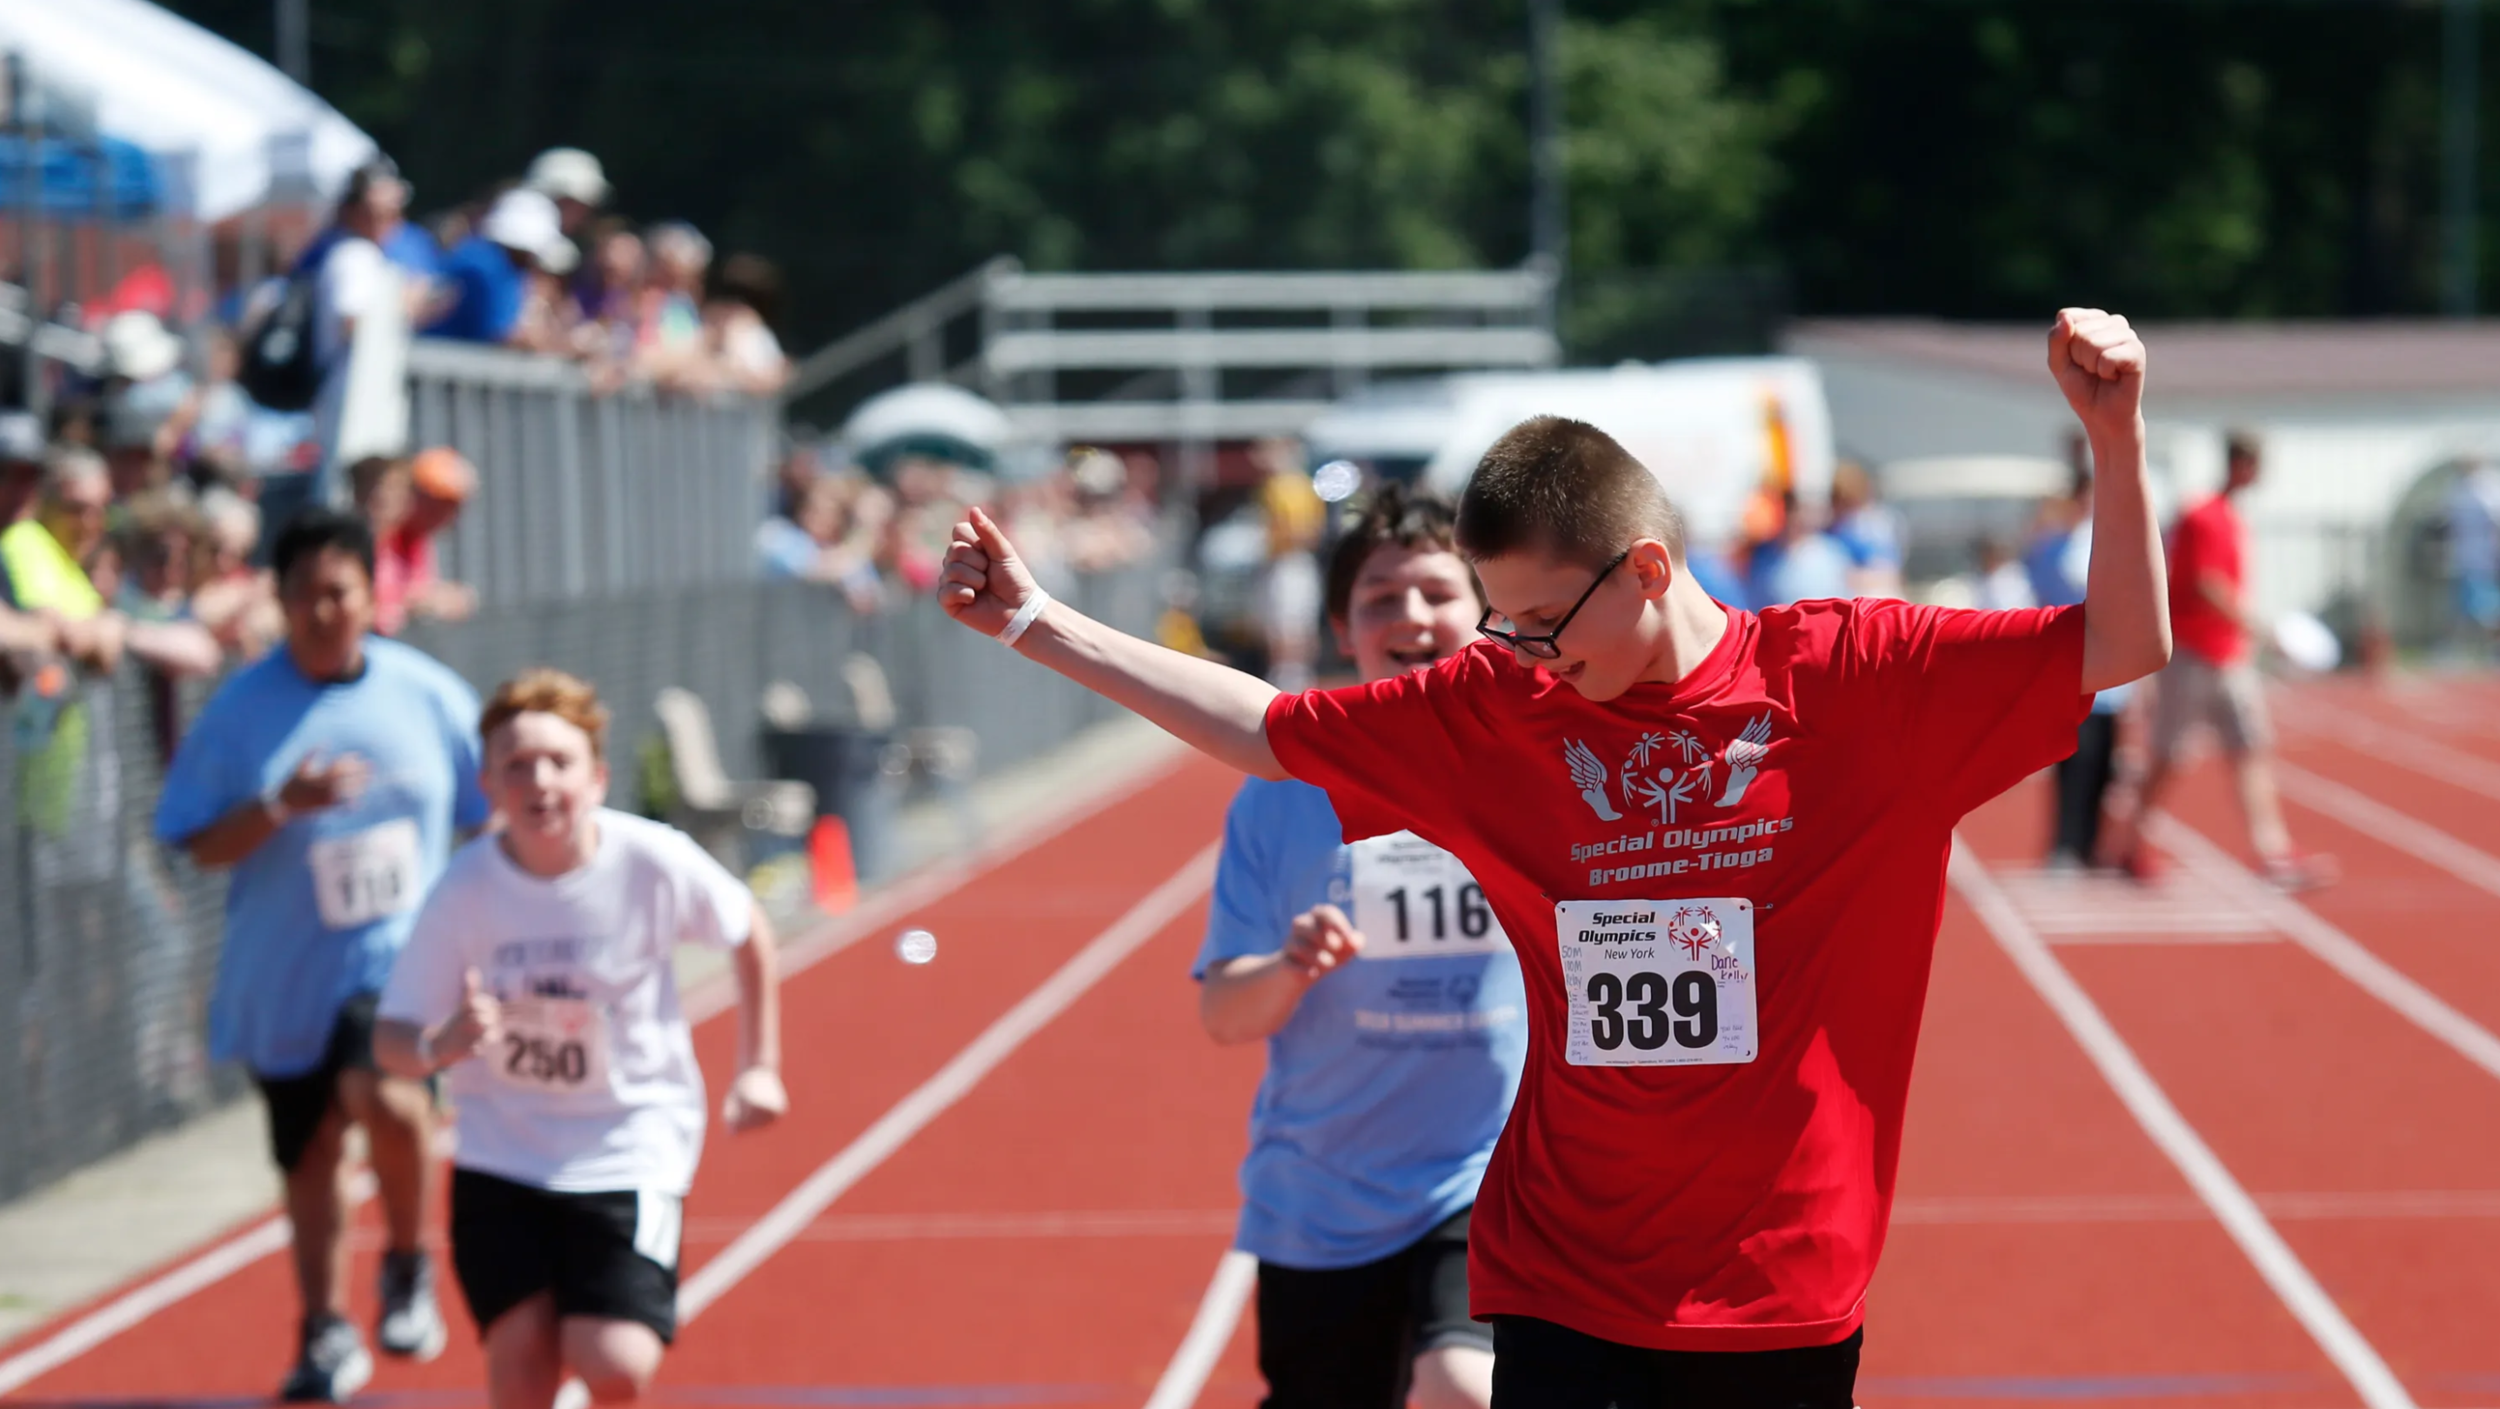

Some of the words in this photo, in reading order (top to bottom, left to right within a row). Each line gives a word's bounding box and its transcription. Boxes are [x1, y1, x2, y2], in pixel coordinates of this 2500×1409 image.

[1571, 832, 1654, 863] Special
[1663, 817, 1794, 849] Olympics
[1589, 847, 1773, 887] Broome-Tioga
[1386, 881, 1491, 941] 116
[1592, 911, 1656, 926] Special
[1578, 930, 1656, 945] Olympics
[1604, 949, 1628, 960] New
[1630, 947, 1655, 960] York
[1711, 954, 1739, 971] Dane
[1587, 970, 1719, 1051] 339
[504, 1028, 588, 1085] 250
